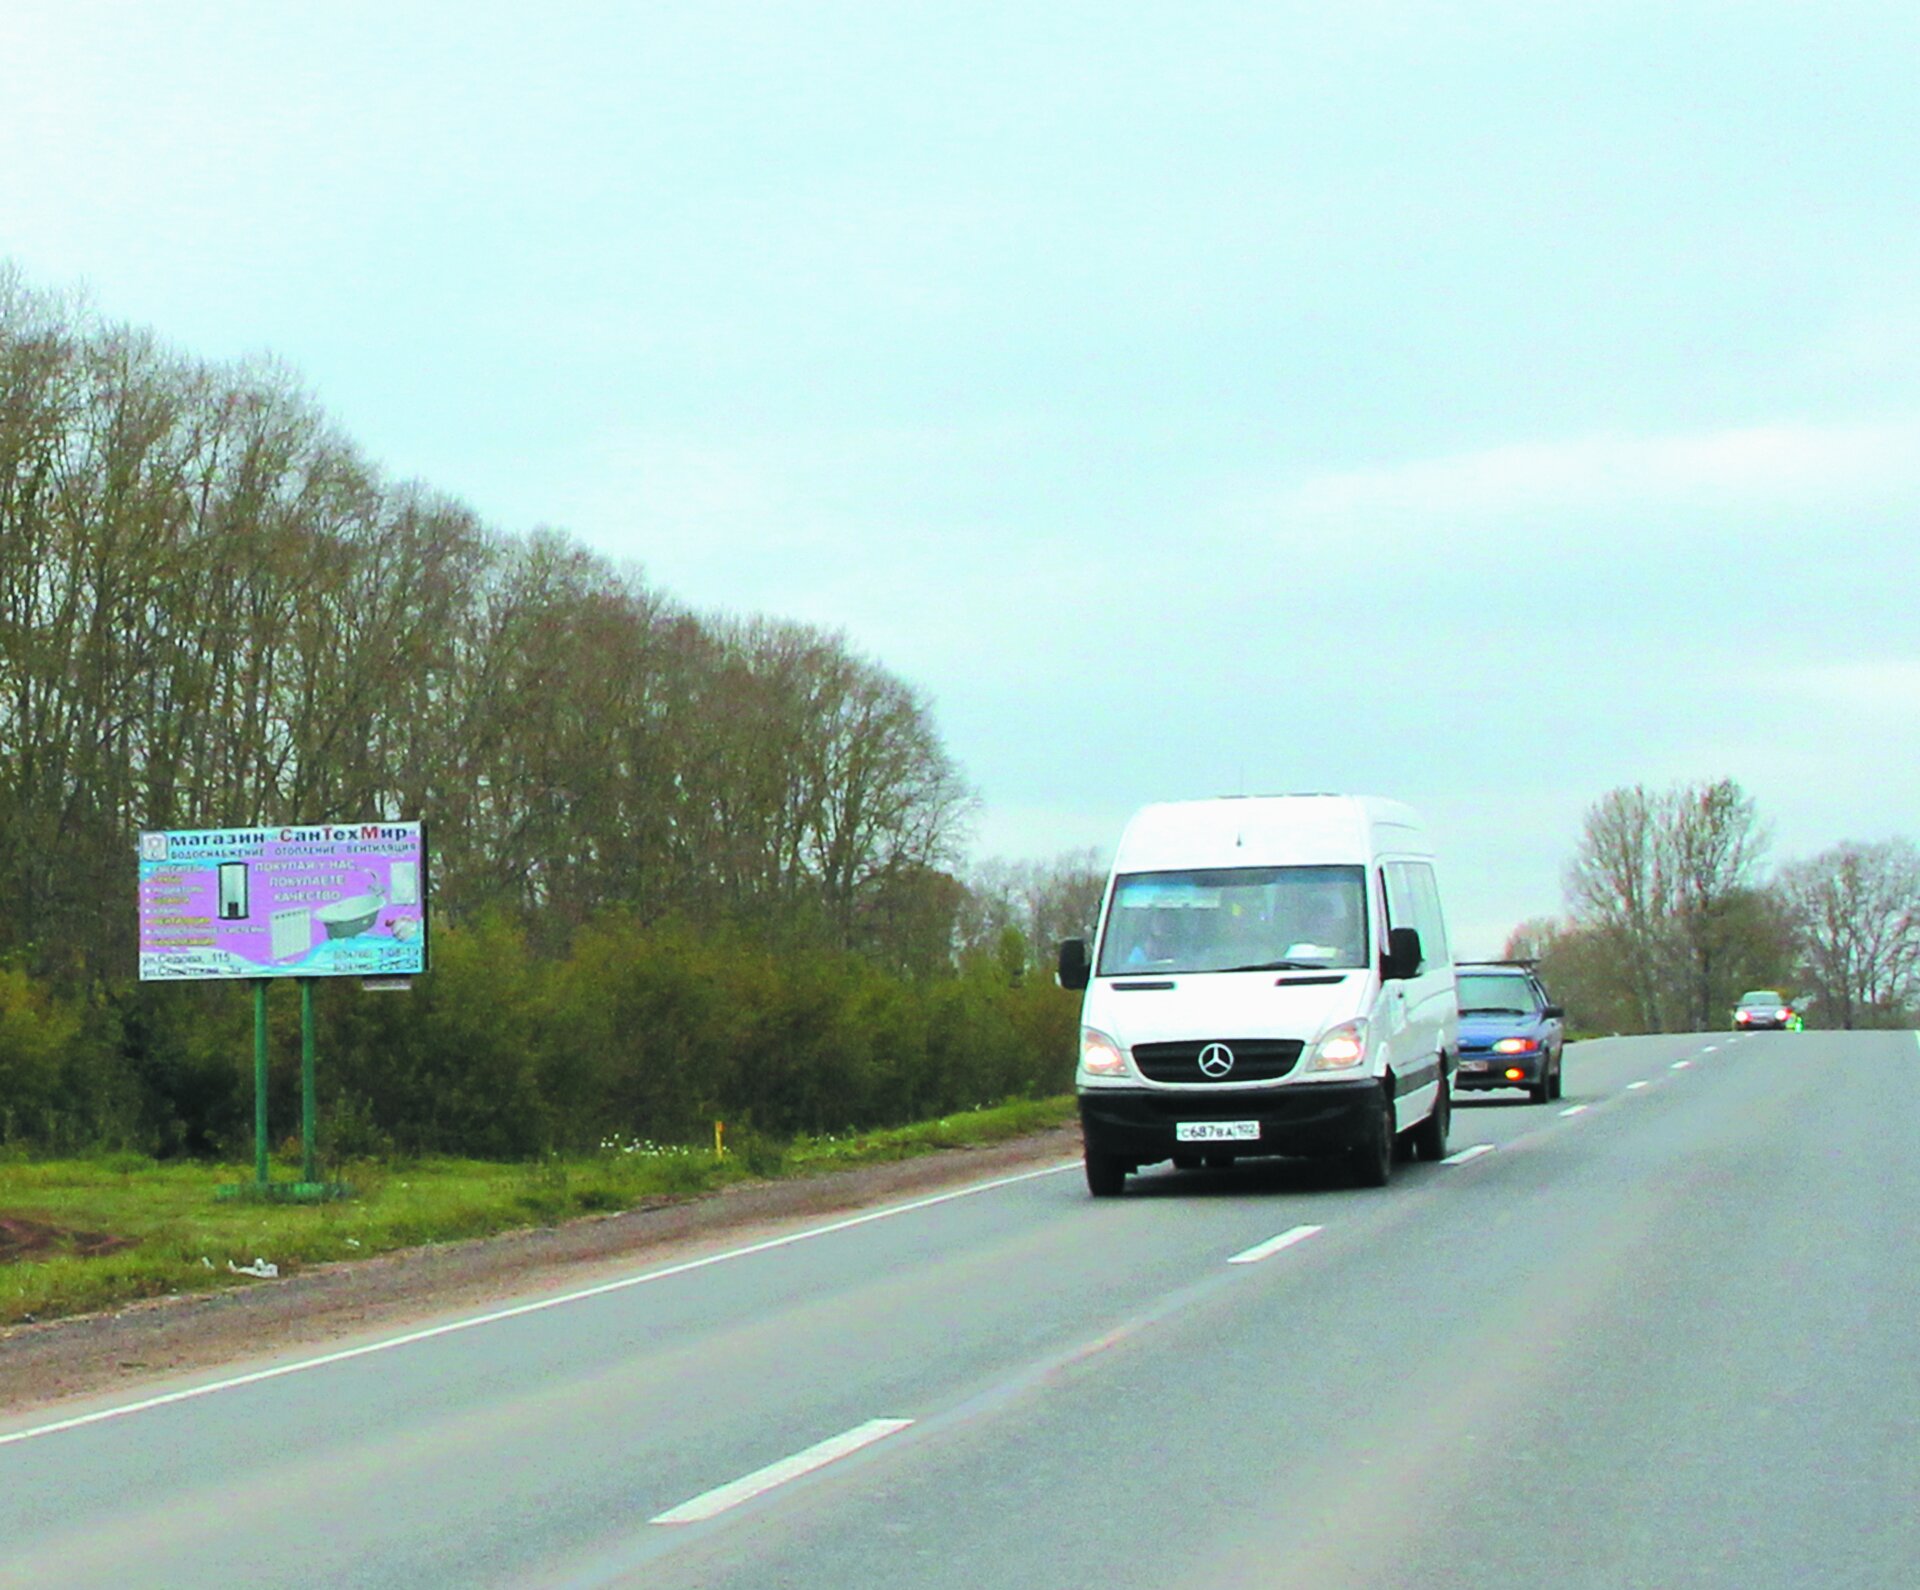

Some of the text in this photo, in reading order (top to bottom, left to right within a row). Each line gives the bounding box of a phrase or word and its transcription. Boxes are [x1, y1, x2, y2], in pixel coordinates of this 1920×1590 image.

[171, 844, 417, 859] ВОДОСНАБЖЕНИЕ ОТОПЛЕНИЕ ВЕНТИЛЯЦИЯ
[270, 875, 345, 887] ПОКУПАЕТЕ
[274, 890, 342, 901] КАЧЕСТВО
